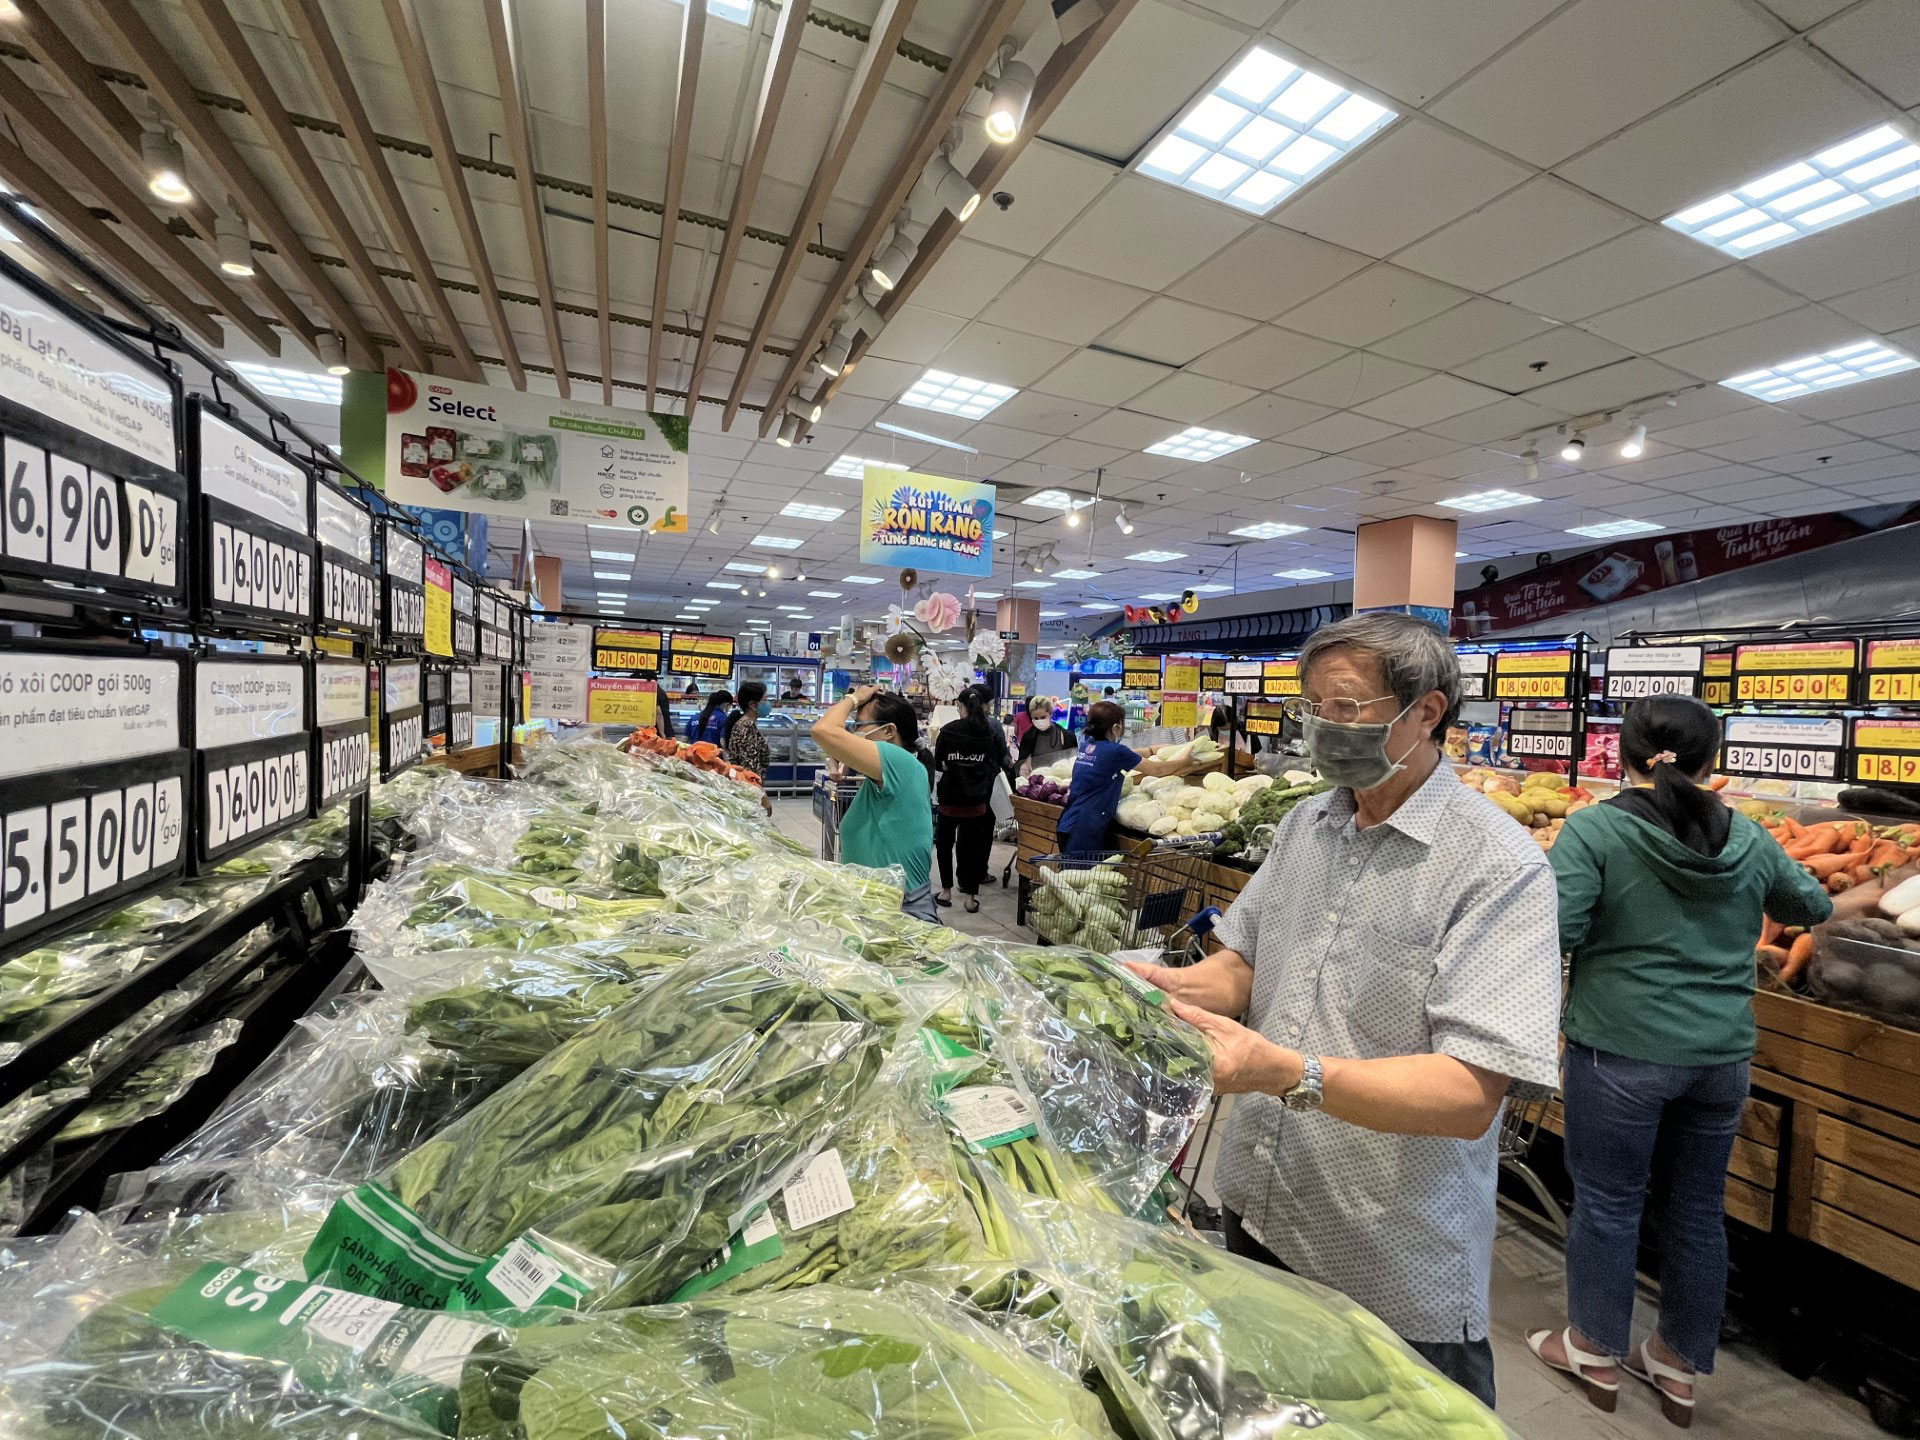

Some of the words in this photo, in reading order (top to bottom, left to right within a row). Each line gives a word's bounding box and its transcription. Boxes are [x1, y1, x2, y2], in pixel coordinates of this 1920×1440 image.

[28, 328, 52, 361] Lạt
[143, 399, 170, 428] 450g
[428, 396, 497, 422] Select
[909, 495, 933, 509] RÚT
[939, 539, 952, 550] HÈ
[953, 542, 980, 555] SANG
[219, 537, 294, 600] 16.000
[810, 642, 819, 650] 01
[599, 653, 646, 665] 21.500
[20, 672, 44, 693] xôi
[50, 673, 93, 692] COOP
[97, 673, 119, 695] gói
[123, 674, 151, 694] 500g
[244, 681, 264, 693] COOP
[591, 682, 622, 690] Khuyến
[1501, 681, 1550, 693] 18.900
[1612, 680, 1675, 693] 20.200
[1741, 679, 1823, 694] 33.500
[14, 707, 46, 728] phẩm
[48, 709, 65, 725] đạt
[68, 707, 85, 721] tiêu
[87, 704, 116, 719] chuẩn
[119, 704, 151, 717] VietGAP
[1514, 738, 1565, 751] 21.500
[325, 743, 361, 787] 16.000
[1730, 750, 1811, 769] 32.500
[1864, 758, 1916, 776] 18.9
[216, 765, 292, 831] 16.000
[163, 819, 180, 844] gói
[340, 1237, 366, 1260] SẢN
[201, 1267, 242, 1297] COOP
[345, 1264, 369, 1286] ĐẠT
